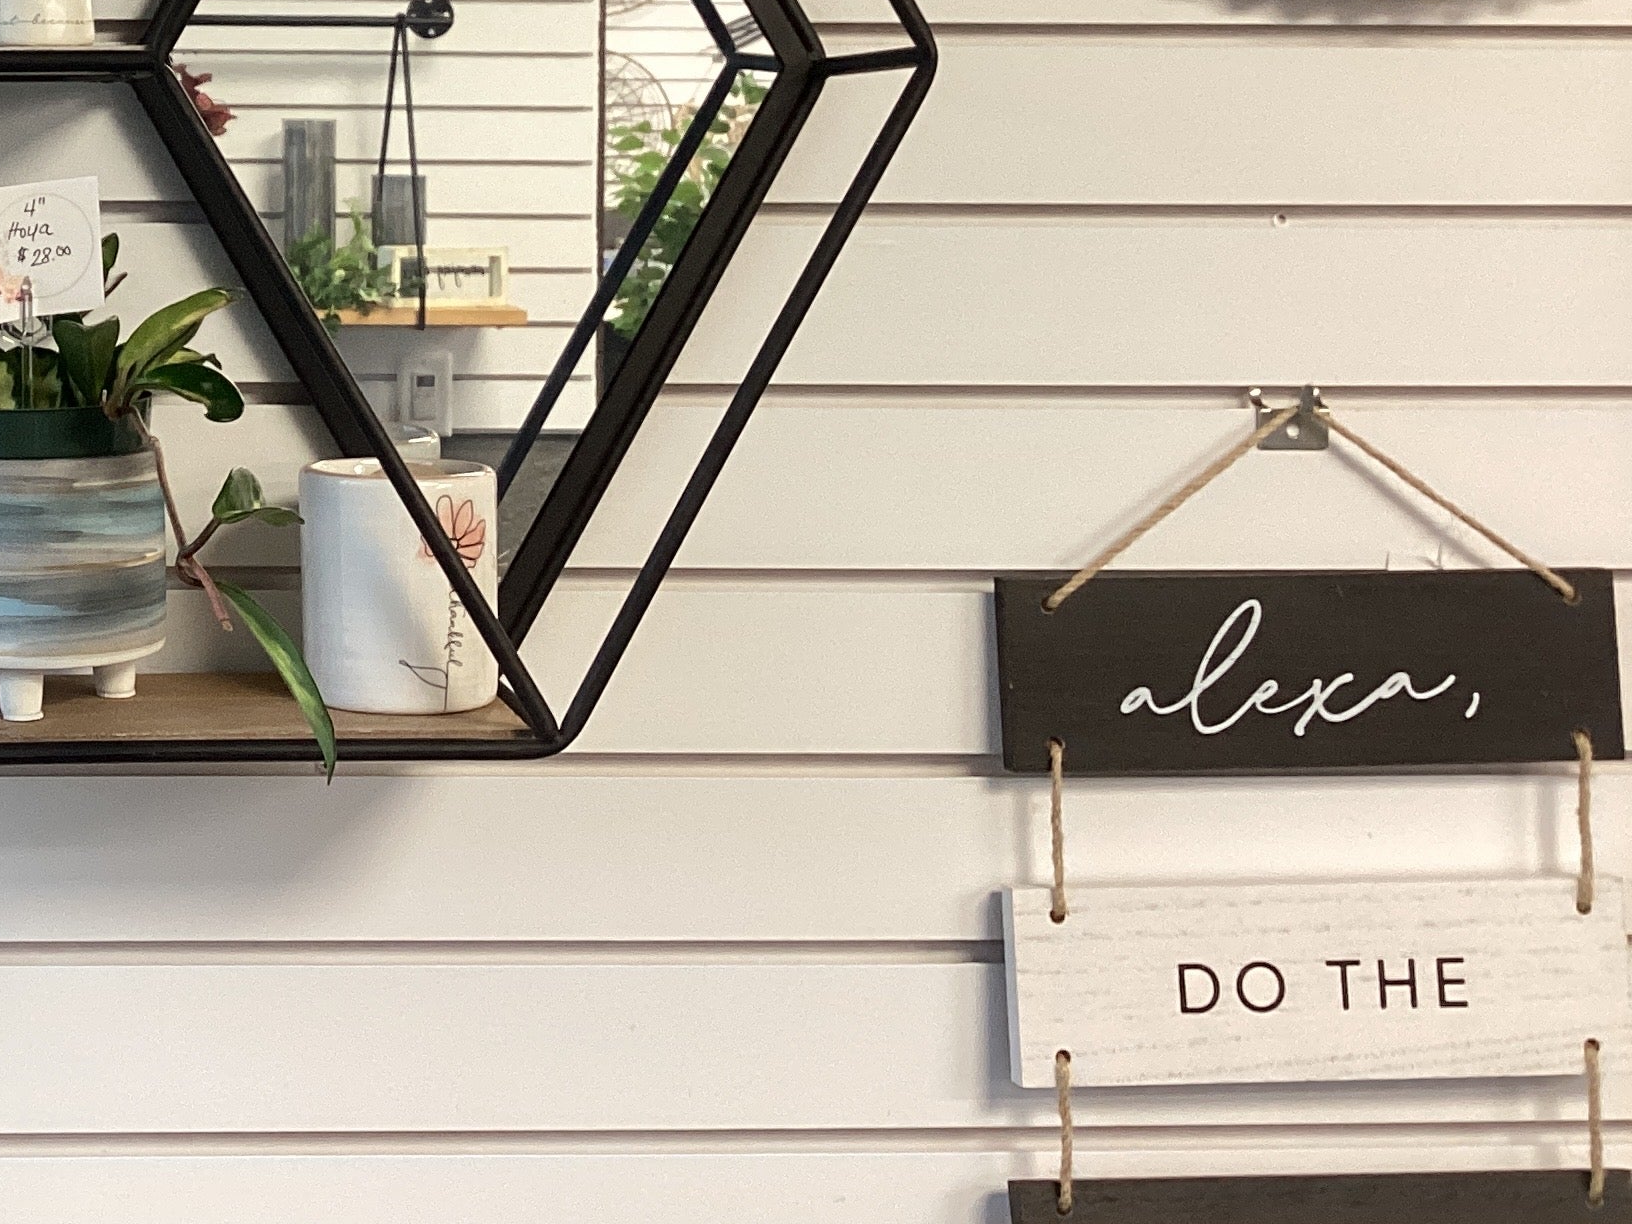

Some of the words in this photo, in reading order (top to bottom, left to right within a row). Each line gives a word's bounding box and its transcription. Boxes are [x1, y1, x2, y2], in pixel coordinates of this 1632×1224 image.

[23, 197, 46, 217] 4"
[7, 221, 53, 241] Hoya
[1119, 597, 1480, 737] alexa,
[1176, 959, 1287, 1015] DO
[1325, 956, 1471, 1012] THE
